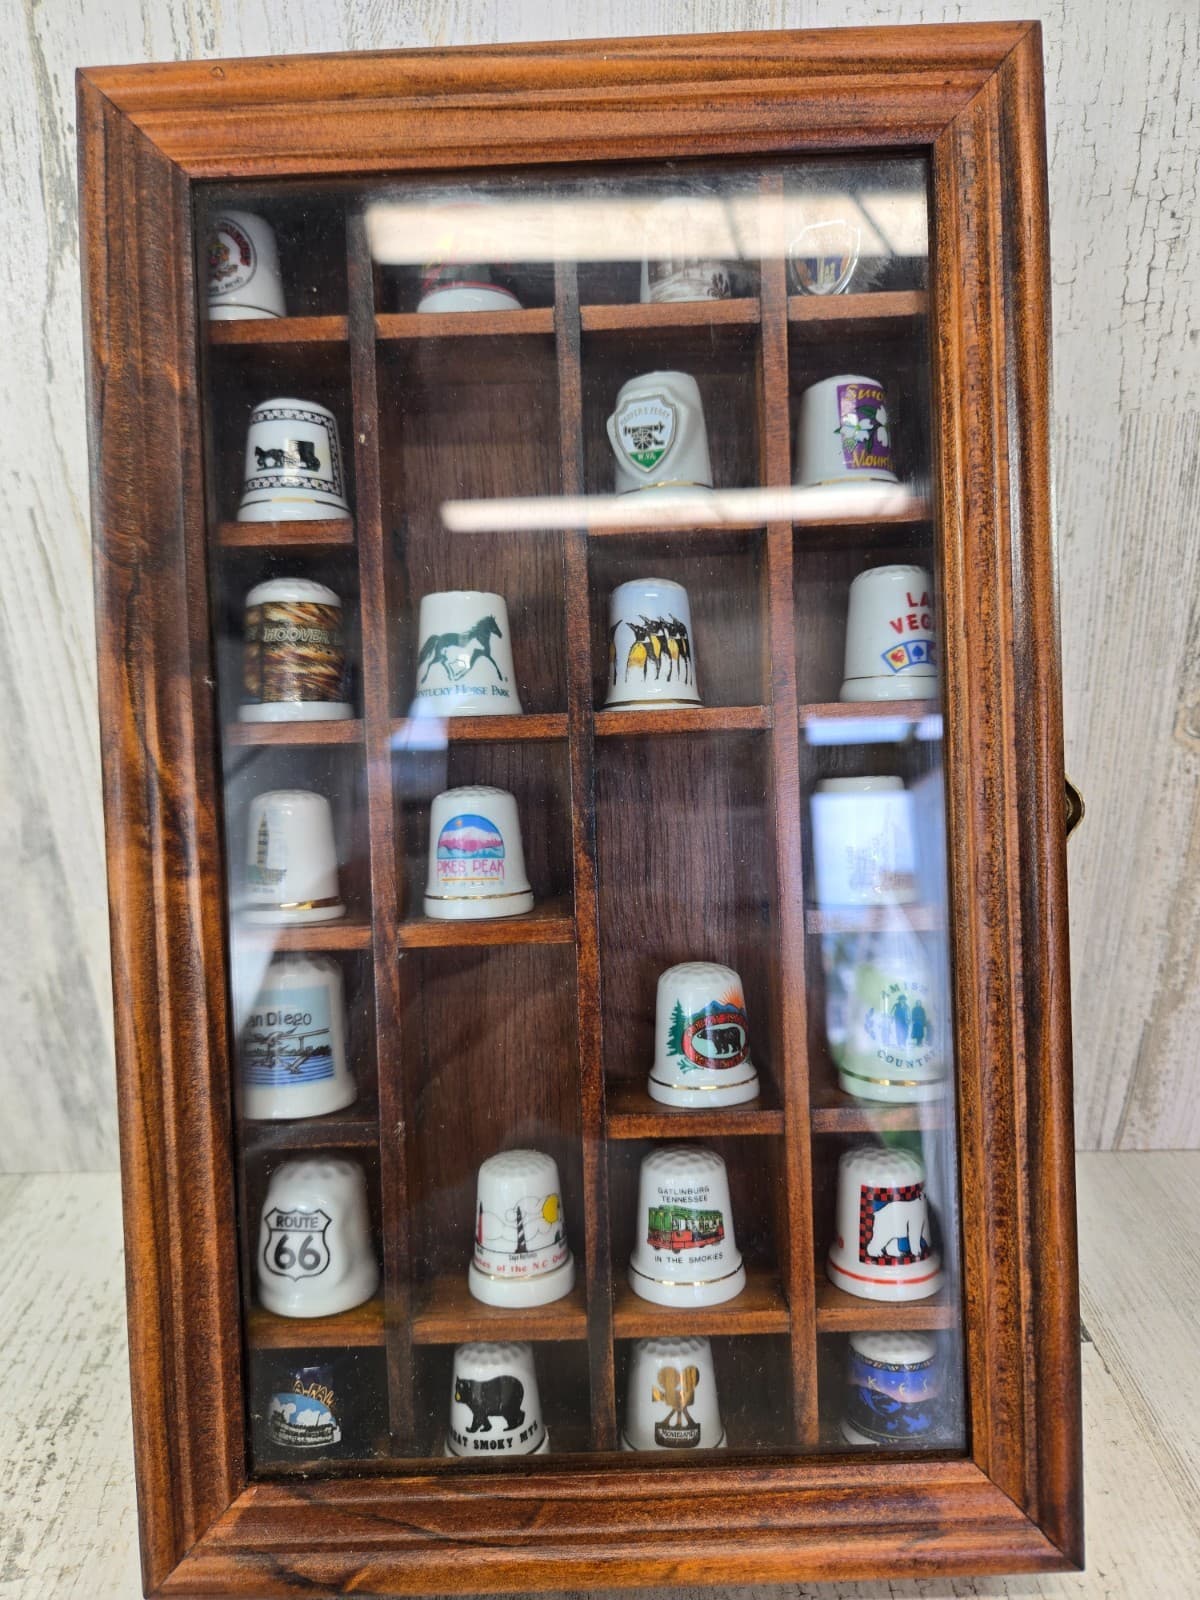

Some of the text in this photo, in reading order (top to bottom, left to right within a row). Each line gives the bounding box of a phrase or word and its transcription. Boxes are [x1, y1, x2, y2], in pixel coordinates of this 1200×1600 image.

[263, 627, 330, 644] HOOVER
[473, 859, 504, 879] PEAK
[266, 1011, 312, 1026] Diego
[657, 1185, 710, 1195] GATLINBURG
[662, 1195, 708, 1204] TENNESSEE
[276, 1215, 319, 1229] ROUTE
[274, 1233, 321, 1271] 66
[654, 1252, 724, 1264] IN THE SMOKIES
[473, 1438, 513, 1450] SMOKY
